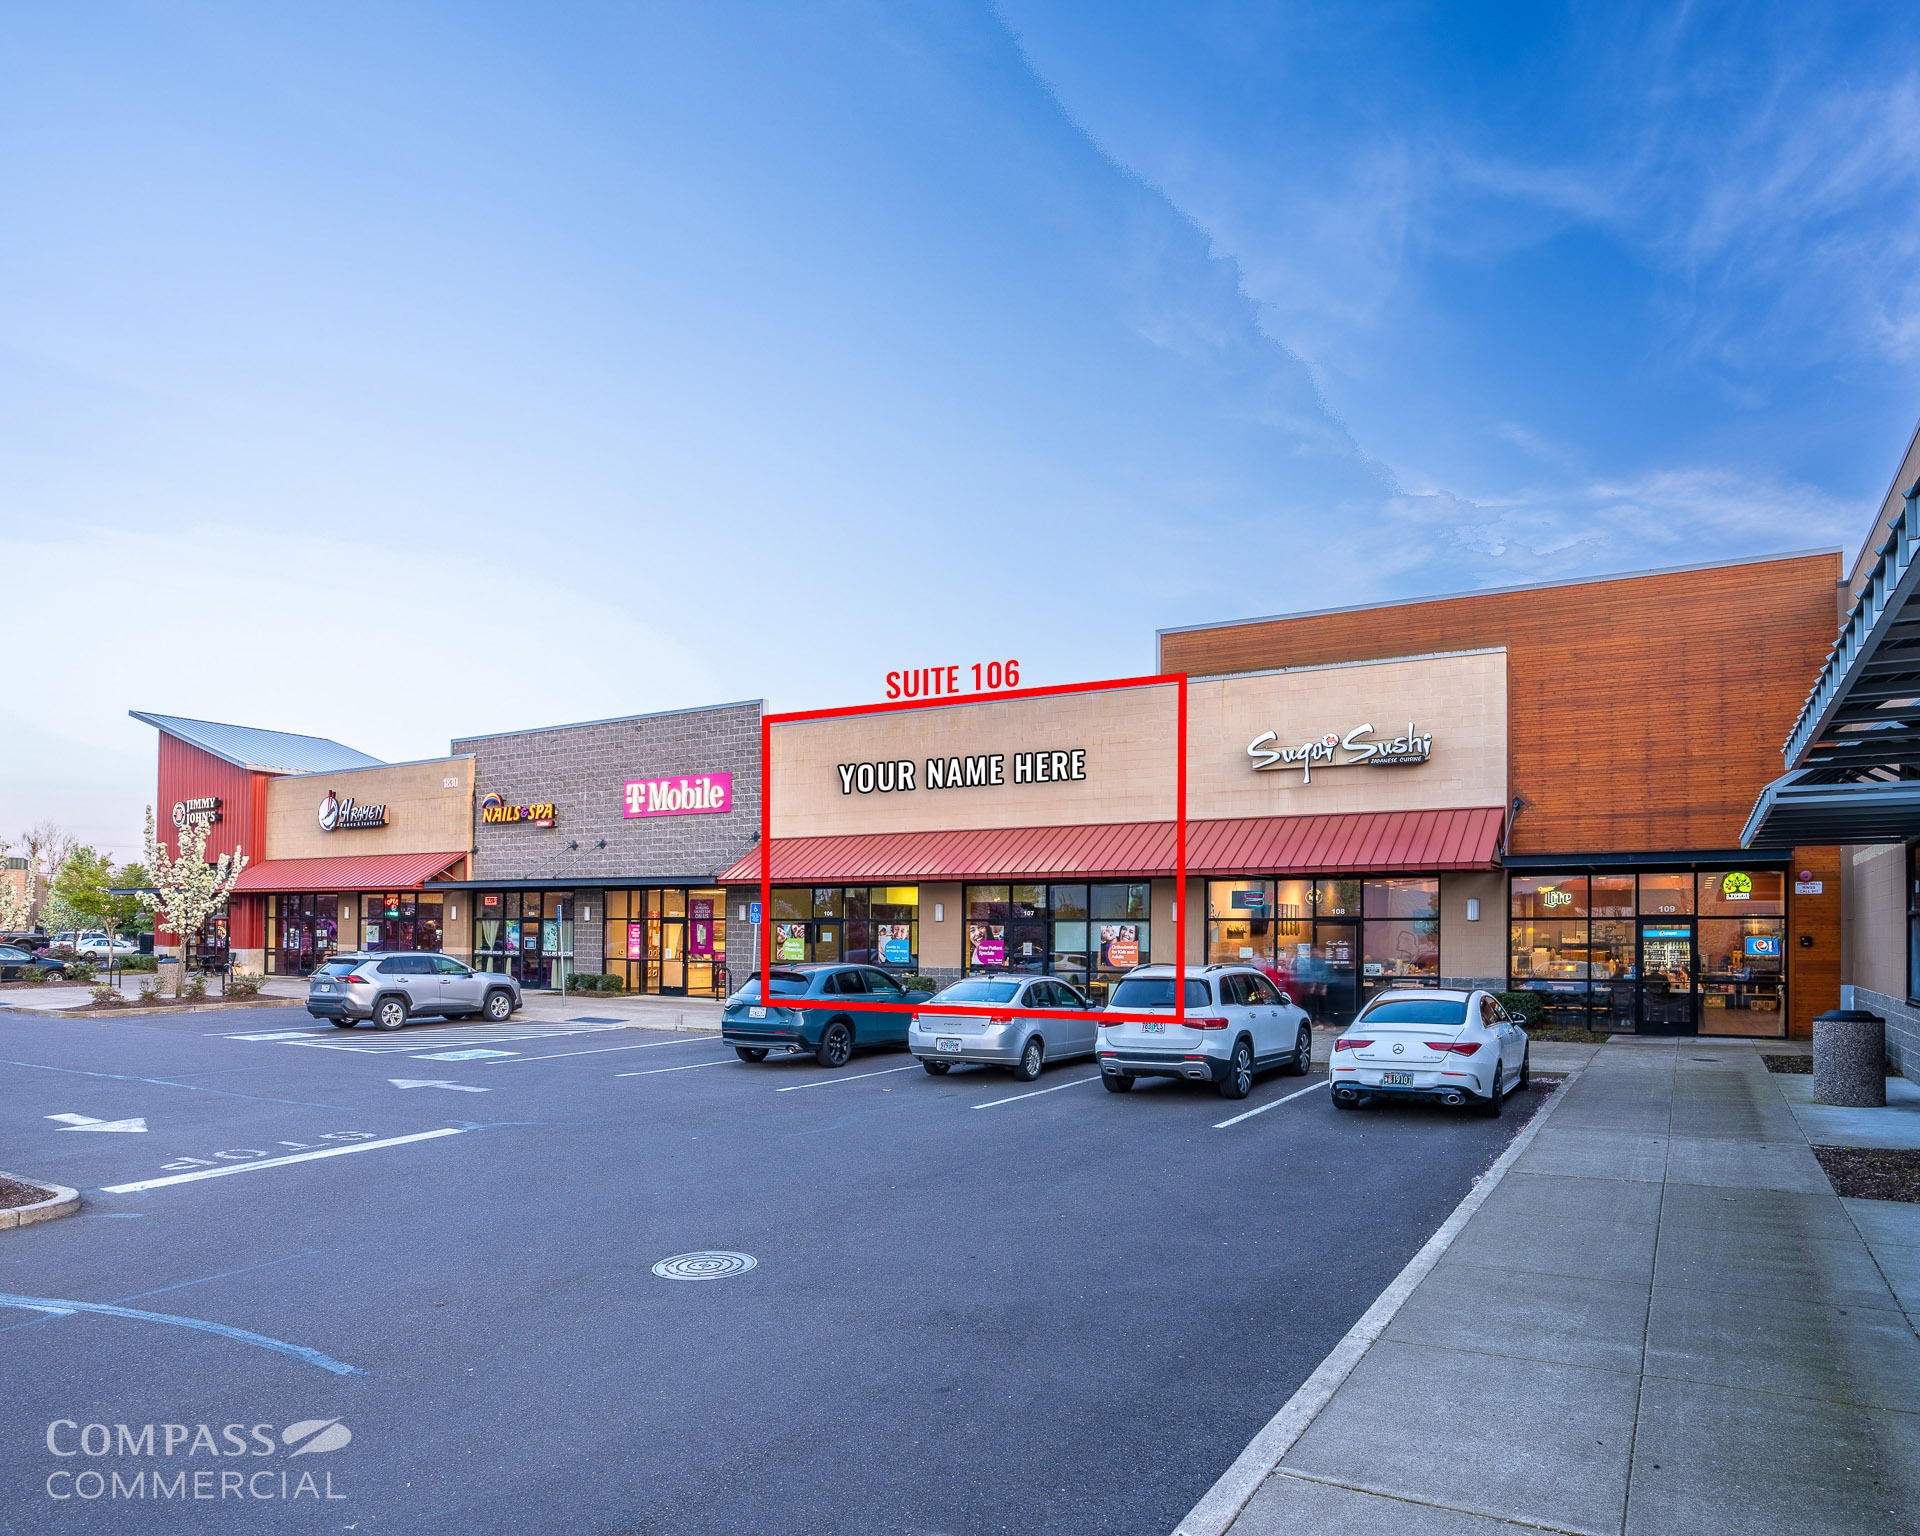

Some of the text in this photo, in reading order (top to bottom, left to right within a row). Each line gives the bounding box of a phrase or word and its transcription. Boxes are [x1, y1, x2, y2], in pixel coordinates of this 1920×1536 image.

[1247, 721, 1433, 784] Sugoi Sushi
[1399, 755, 1422, 763] CUISINE
[443, 777, 458, 788] 1830
[647, 778, 725, 811] Mobile
[186, 797, 216, 813] JIMMY
[482, 803, 555, 823] NAILS & SPA
[186, 811, 216, 826] JOHN'S
[1544, 891, 1572, 908] Lite
[160, 1131, 377, 1170] STOP
